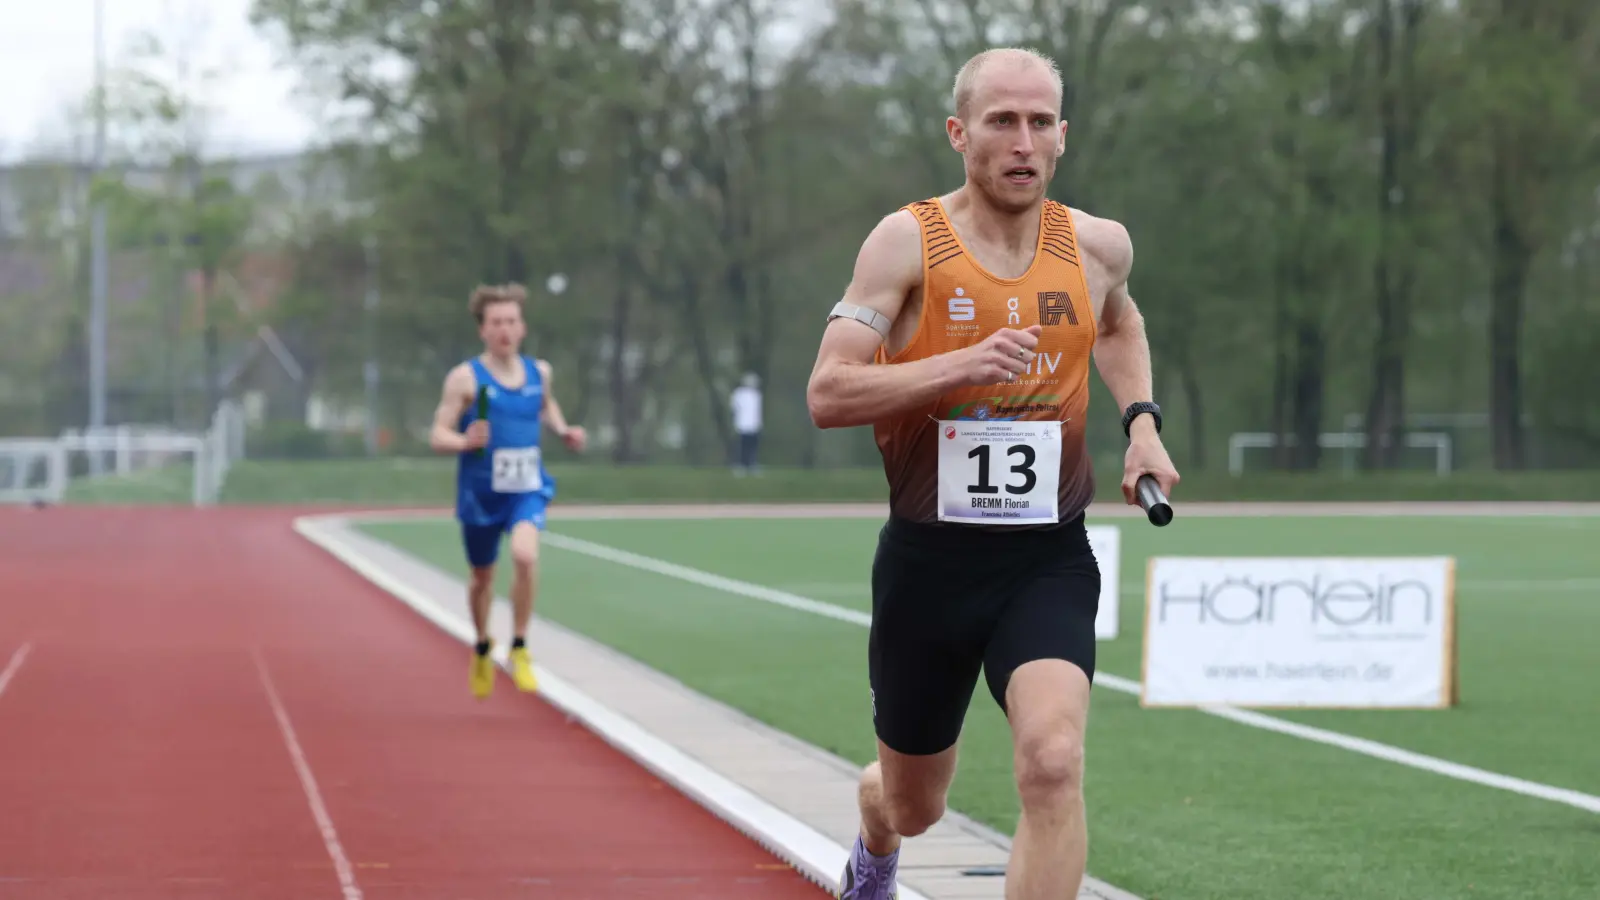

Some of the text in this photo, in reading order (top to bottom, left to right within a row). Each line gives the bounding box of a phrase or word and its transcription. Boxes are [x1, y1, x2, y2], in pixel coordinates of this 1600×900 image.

[967, 444, 1037, 495] 13
[971, 497, 1030, 509] BREMM Florian
[1158, 574, 1433, 626] Härlein
